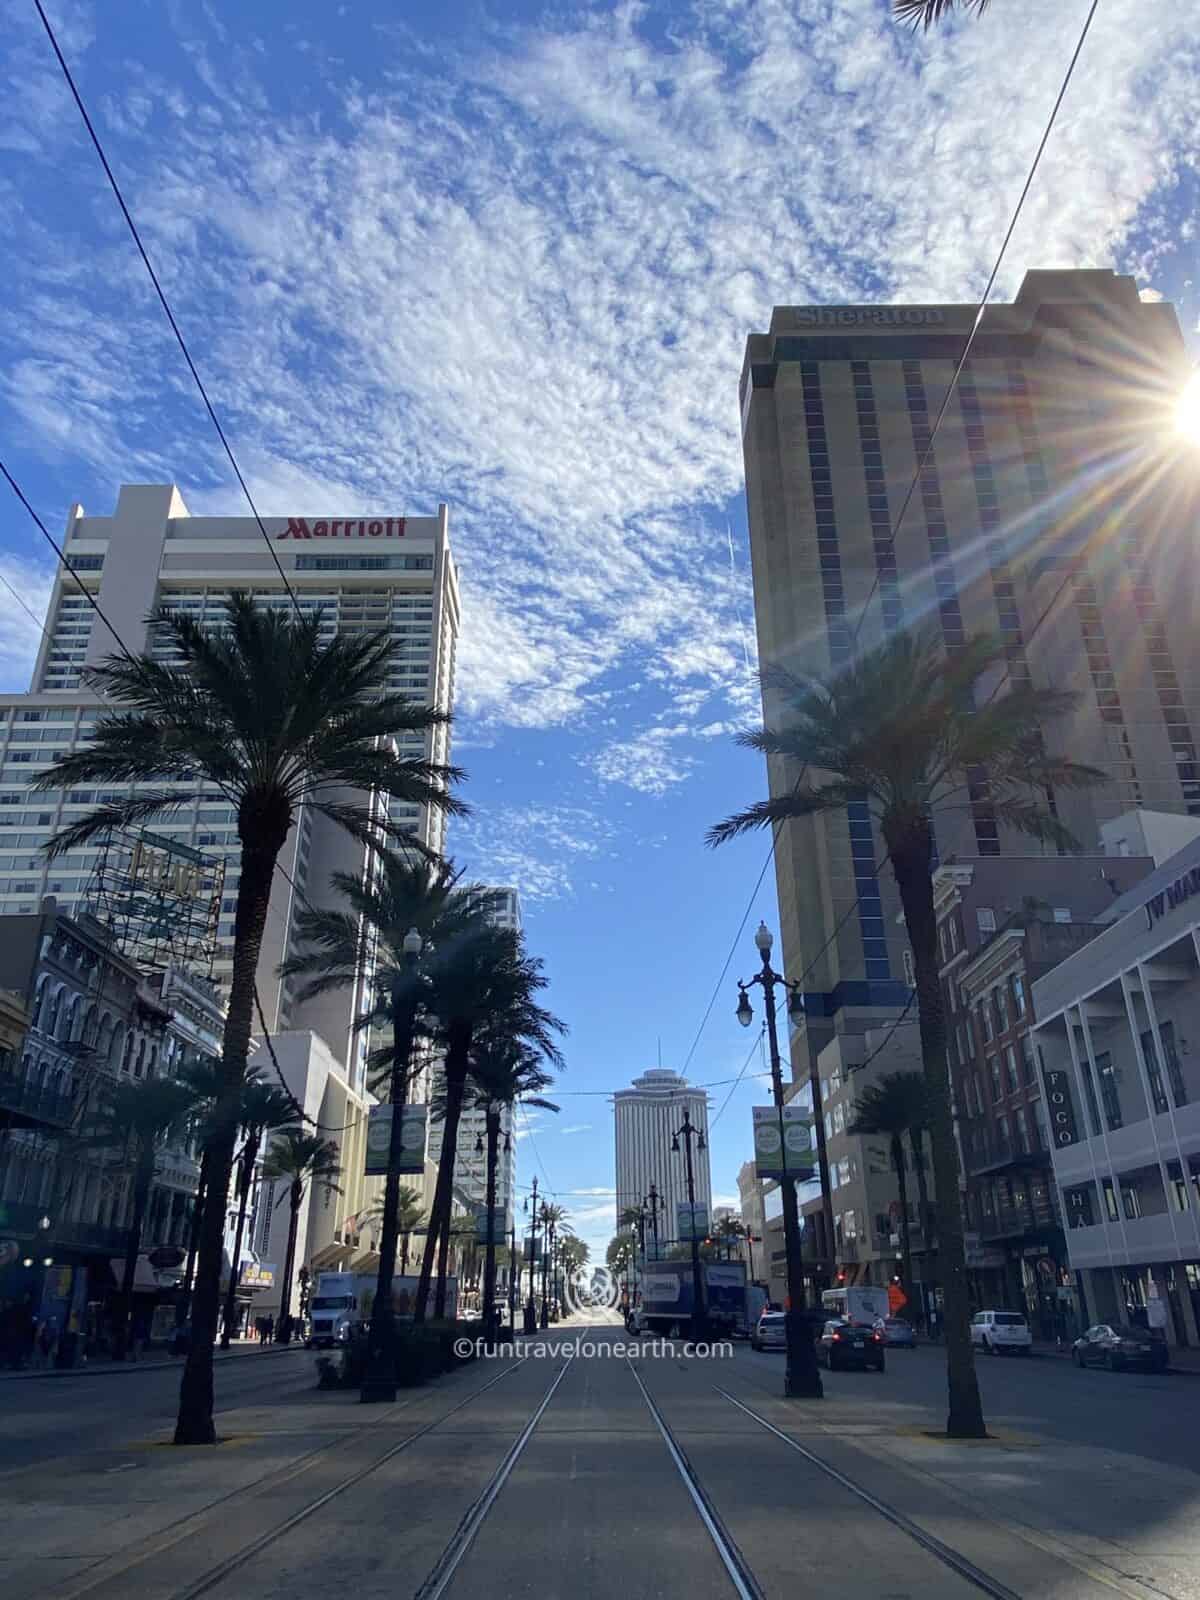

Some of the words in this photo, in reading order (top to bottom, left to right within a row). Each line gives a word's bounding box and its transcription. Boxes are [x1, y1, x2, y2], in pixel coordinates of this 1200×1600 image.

[796, 306, 945, 328] Sheraton
[276, 516, 408, 540] Marriott
[1144, 890, 1166, 931] JW
[1050, 1072, 1073, 1144] FOGO
